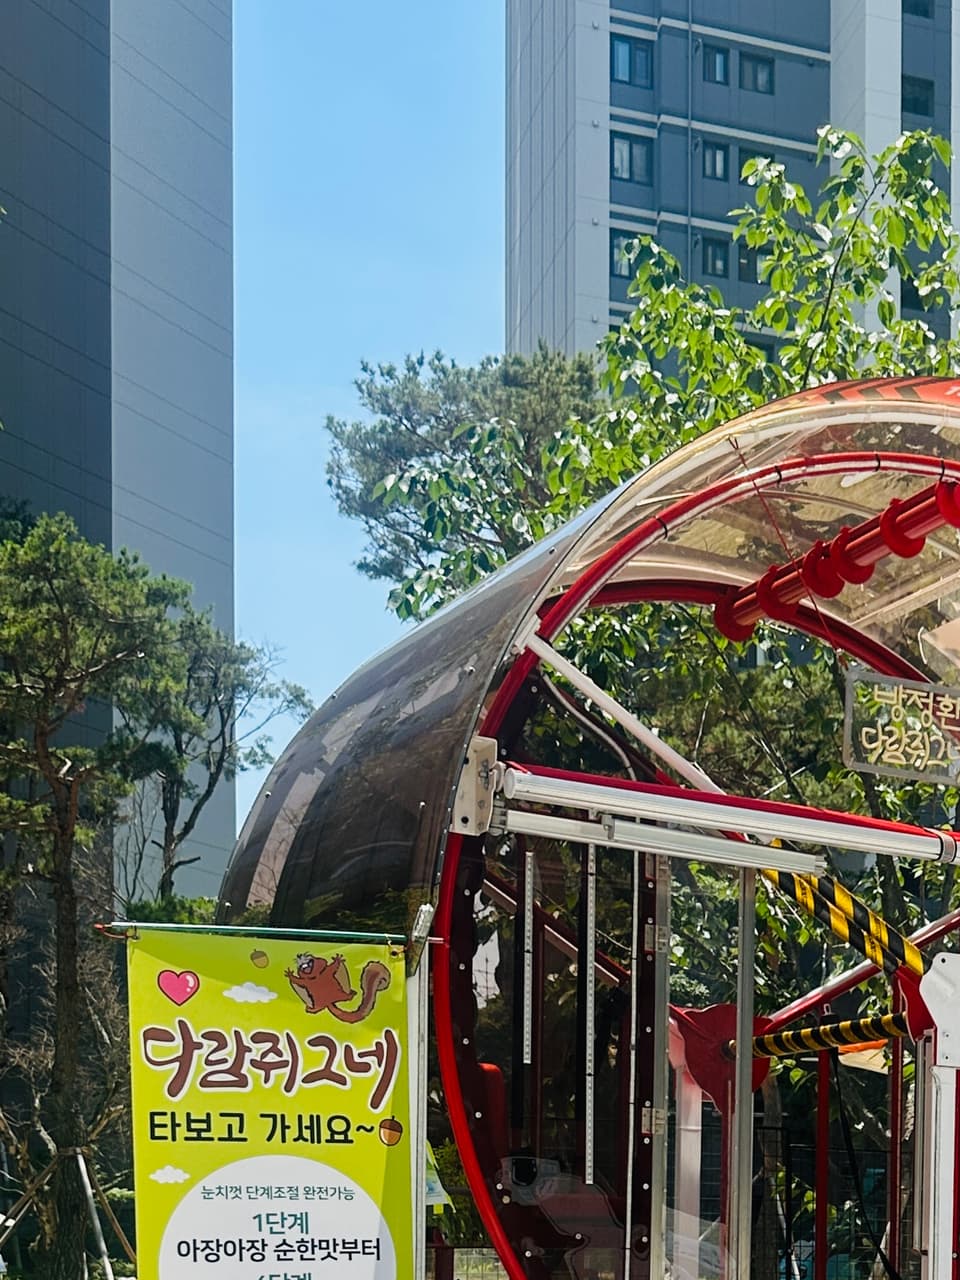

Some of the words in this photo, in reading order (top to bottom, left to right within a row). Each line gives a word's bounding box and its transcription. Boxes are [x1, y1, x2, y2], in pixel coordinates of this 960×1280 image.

[142, 1018, 400, 1111] 다람쥐그네
[149, 1111, 249, 1142] 타보고
[259, 1113, 375, 1144] 가세요~
[201, 1185, 243, 1201] 눈치껏
[246, 1185, 300, 1201] 단계조절
[303, 1186, 356, 1201] 완전가능
[253, 1211, 310, 1235] 1단계
[177, 1238, 268, 1263] 아장아장
[273, 1238, 381, 1262] 순한맛부터
